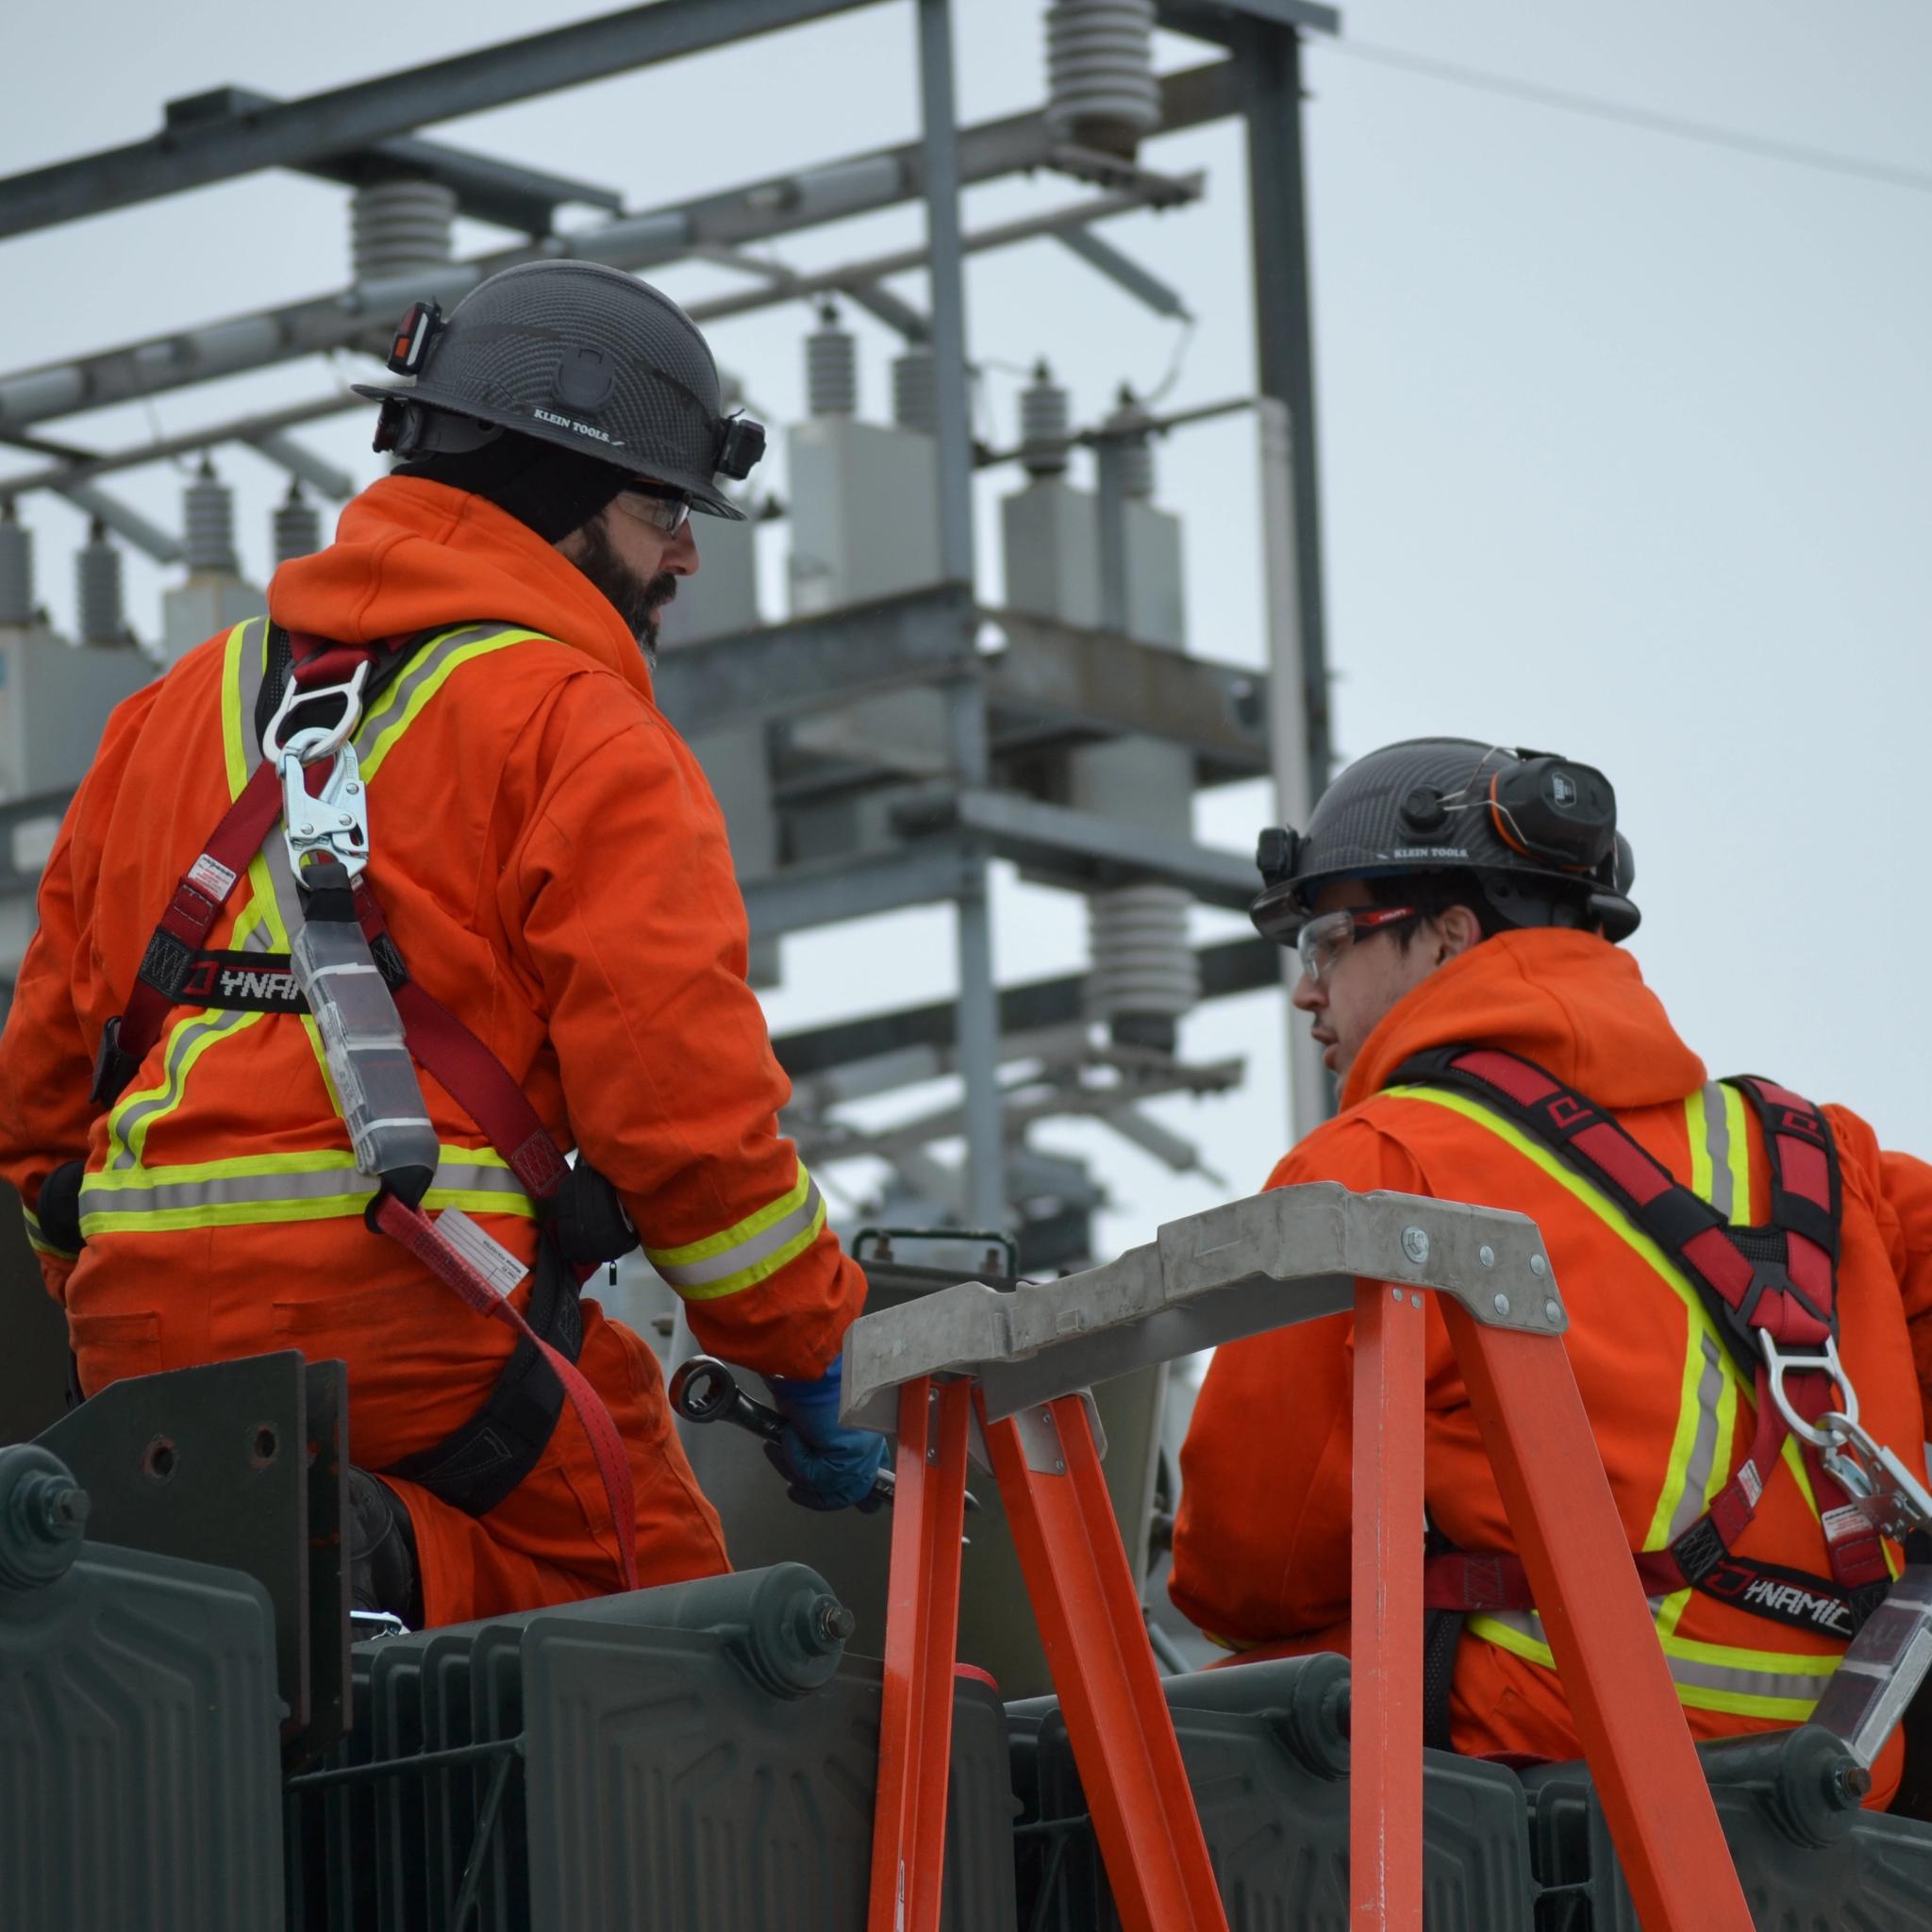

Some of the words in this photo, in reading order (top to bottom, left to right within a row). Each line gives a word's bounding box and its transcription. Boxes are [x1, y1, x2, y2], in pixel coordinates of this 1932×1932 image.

[534, 408, 571, 428] KLEIN
[573, 421, 609, 442] TOOLS
[1394, 848, 1428, 858] KLEIN
[1431, 848, 1468, 858] TOOLS
